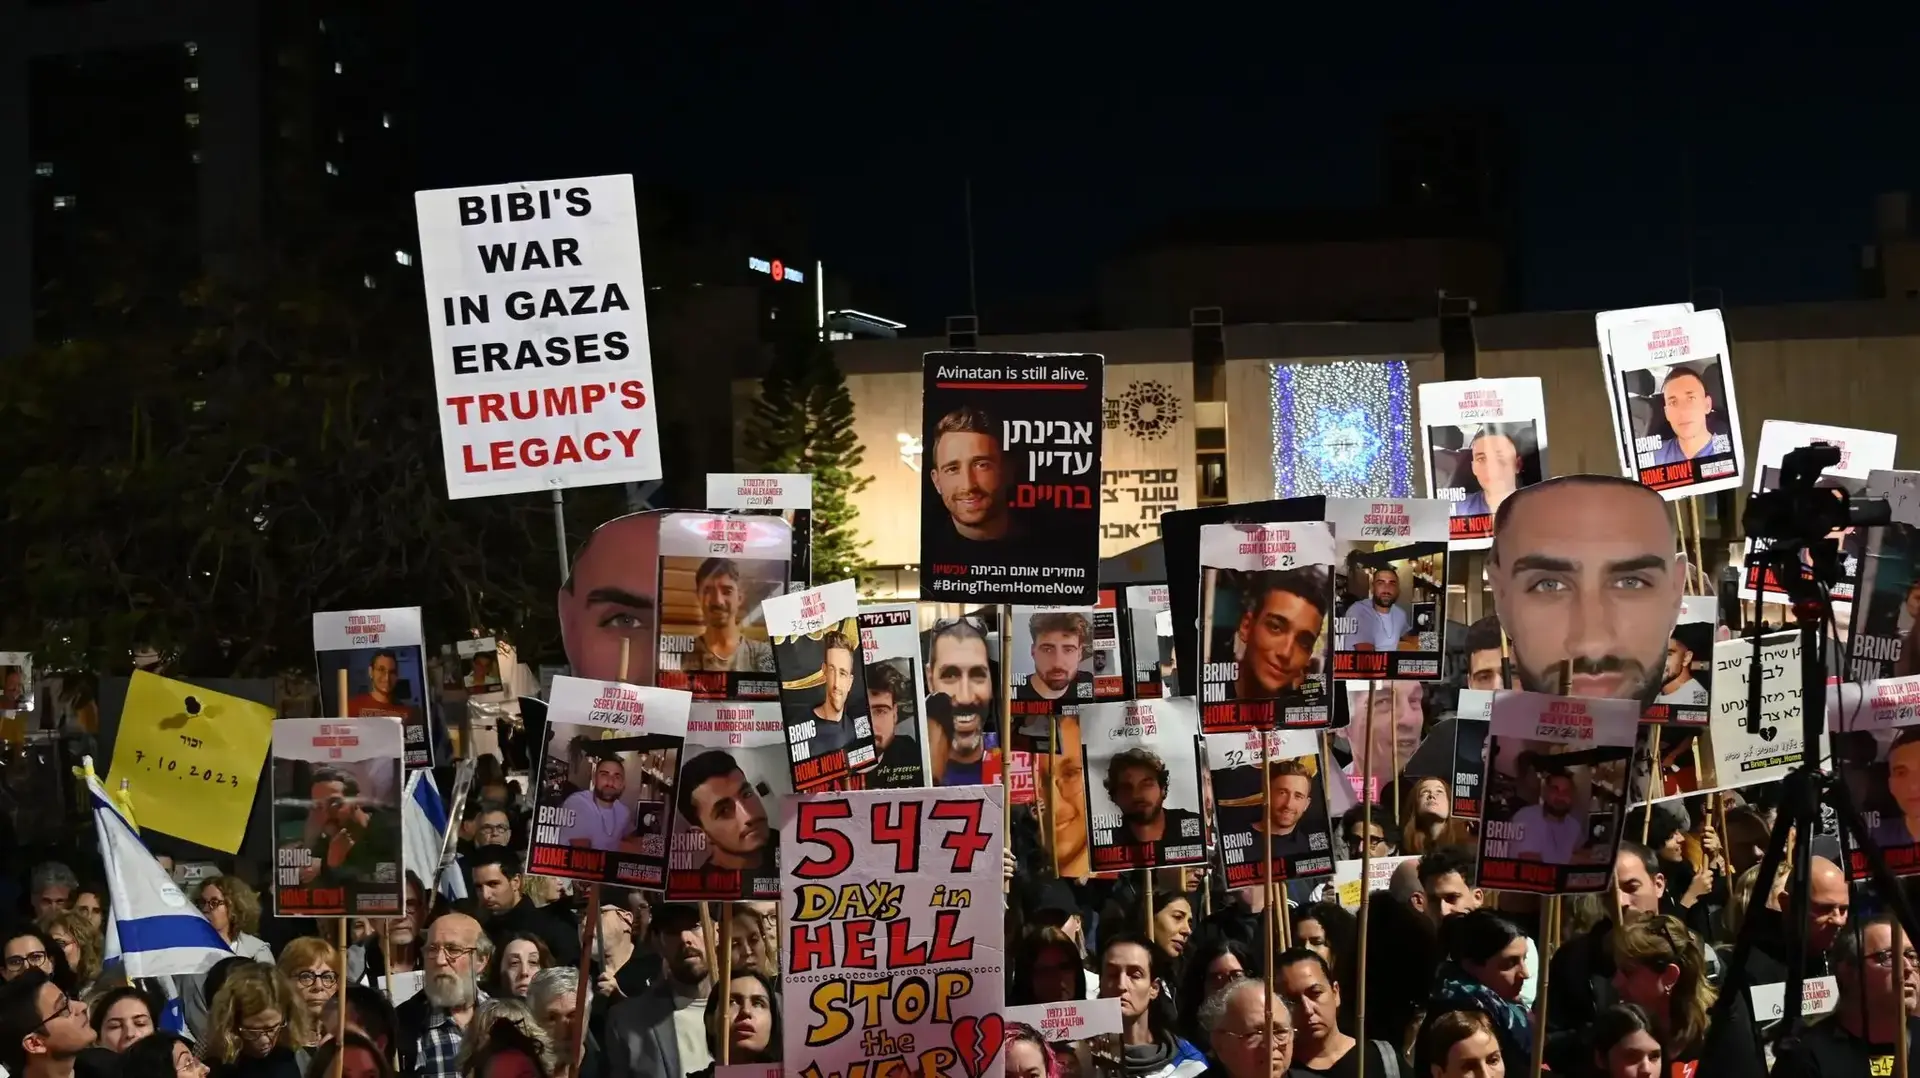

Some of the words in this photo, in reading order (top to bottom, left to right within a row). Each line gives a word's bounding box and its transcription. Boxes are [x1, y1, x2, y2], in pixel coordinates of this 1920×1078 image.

[458, 187, 592, 226] BIBI'S
[478, 237, 582, 273] WAR
[443, 294, 490, 326] IN
[505, 283, 629, 320] GAZA
[452, 331, 629, 374] ERASES
[937, 366, 1001, 380] Avinatan
[1006, 366, 1017, 380] is
[1021, 366, 1047, 380] still
[1051, 367, 1089, 380] alive.
[446, 380, 646, 425] TRUMP'S
[1003, 419, 1093, 451] אבינתן
[463, 428, 642, 473] LEGACY
[1635, 435, 1662, 453] BRING
[1029, 450, 1092, 481] עדיין
[1638, 452, 1656, 469] HIM
[1102, 469, 1177, 484] ספריית
[1641, 468, 1665, 485] HOME
[1666, 461, 1693, 480] NOW!
[752, 487, 783, 496] ALEXANDER
[1009, 484, 1092, 509] בחיים.
[1437, 487, 1466, 501] BRING
[1363, 514, 1384, 525] SEGEV
[1385, 514, 1410, 525] KALFON
[1450, 517, 1467, 533] OME
[1239, 543, 1257, 554] EDAN
[1258, 542, 1296, 553] ALEXANDER
[932, 564, 968, 576] עכשיו!
[970, 565, 1006, 577] הביתה
[1010, 566, 1038, 577] אותם
[1042, 566, 1085, 577] מחזירים
[932, 581, 1084, 595] #BringThemHomeNow
[886, 611, 909, 624] יותר
[1334, 617, 1358, 633] RING
[660, 635, 695, 652] BRING
[1854, 634, 1901, 662] BRING
[659, 652, 682, 671] HIM
[1334, 654, 1354, 670] OME
[1356, 653, 1387, 670] NOW!
[1717, 658, 1742, 671] שוב
[1203, 662, 1239, 682] BRING
[1850, 656, 1881, 685] HIM
[1011, 673, 1027, 686] ING
[1203, 683, 1226, 702] HIM
[593, 698, 615, 711] SEGEV
[615, 700, 644, 713] KALFON
[1011, 702, 1025, 714] ME
[1203, 704, 1236, 724] HOME
[1239, 701, 1274, 722] NOW!
[1784, 706, 1801, 719] לא
[714, 720, 754, 731] MORDECHAI
[756, 720, 784, 731] SAMERA
[1124, 716, 1140, 726] ALON
[1141, 715, 1156, 725] OHEL
[728, 733, 742, 744] (21)
[788, 719, 816, 743] BRING
[180, 735, 203, 749] זכור
[791, 741, 811, 762] HIM
[1224, 750, 1247, 767] 32
[794, 759, 820, 781] HOME
[821, 749, 847, 773] NOW!
[1456, 772, 1479, 786] BRING
[1456, 785, 1470, 798] HIM
[1455, 798, 1476, 810] HOME
[538, 806, 576, 827] BRING
[1092, 814, 1122, 829] BRING
[536, 825, 561, 845] HIM
[1093, 829, 1113, 846] HIM
[1486, 820, 1525, 840] BRING
[669, 833, 706, 850] BRING
[791, 799, 993, 879] 547
[1223, 832, 1253, 849] BRING
[1095, 846, 1124, 862] HOME
[1225, 848, 1244, 864] HIM
[1484, 838, 1510, 858] HIM
[278, 849, 312, 866] BRING
[533, 846, 568, 868] HOME
[571, 850, 606, 872] NOW!
[669, 852, 693, 870] HIM
[279, 867, 300, 885] HIM
[1227, 864, 1257, 881] HOME
[753, 884, 777, 893] FAMILIES
[791, 880, 905, 922] DAYS
[929, 885, 971, 908] in
[789, 910, 975, 974] HELL
[805, 970, 974, 1047] STOP
[1041, 1019, 1060, 1029] SEGEV
[1061, 1017, 1084, 1026] KALFON
[860, 1029, 915, 1057] the
